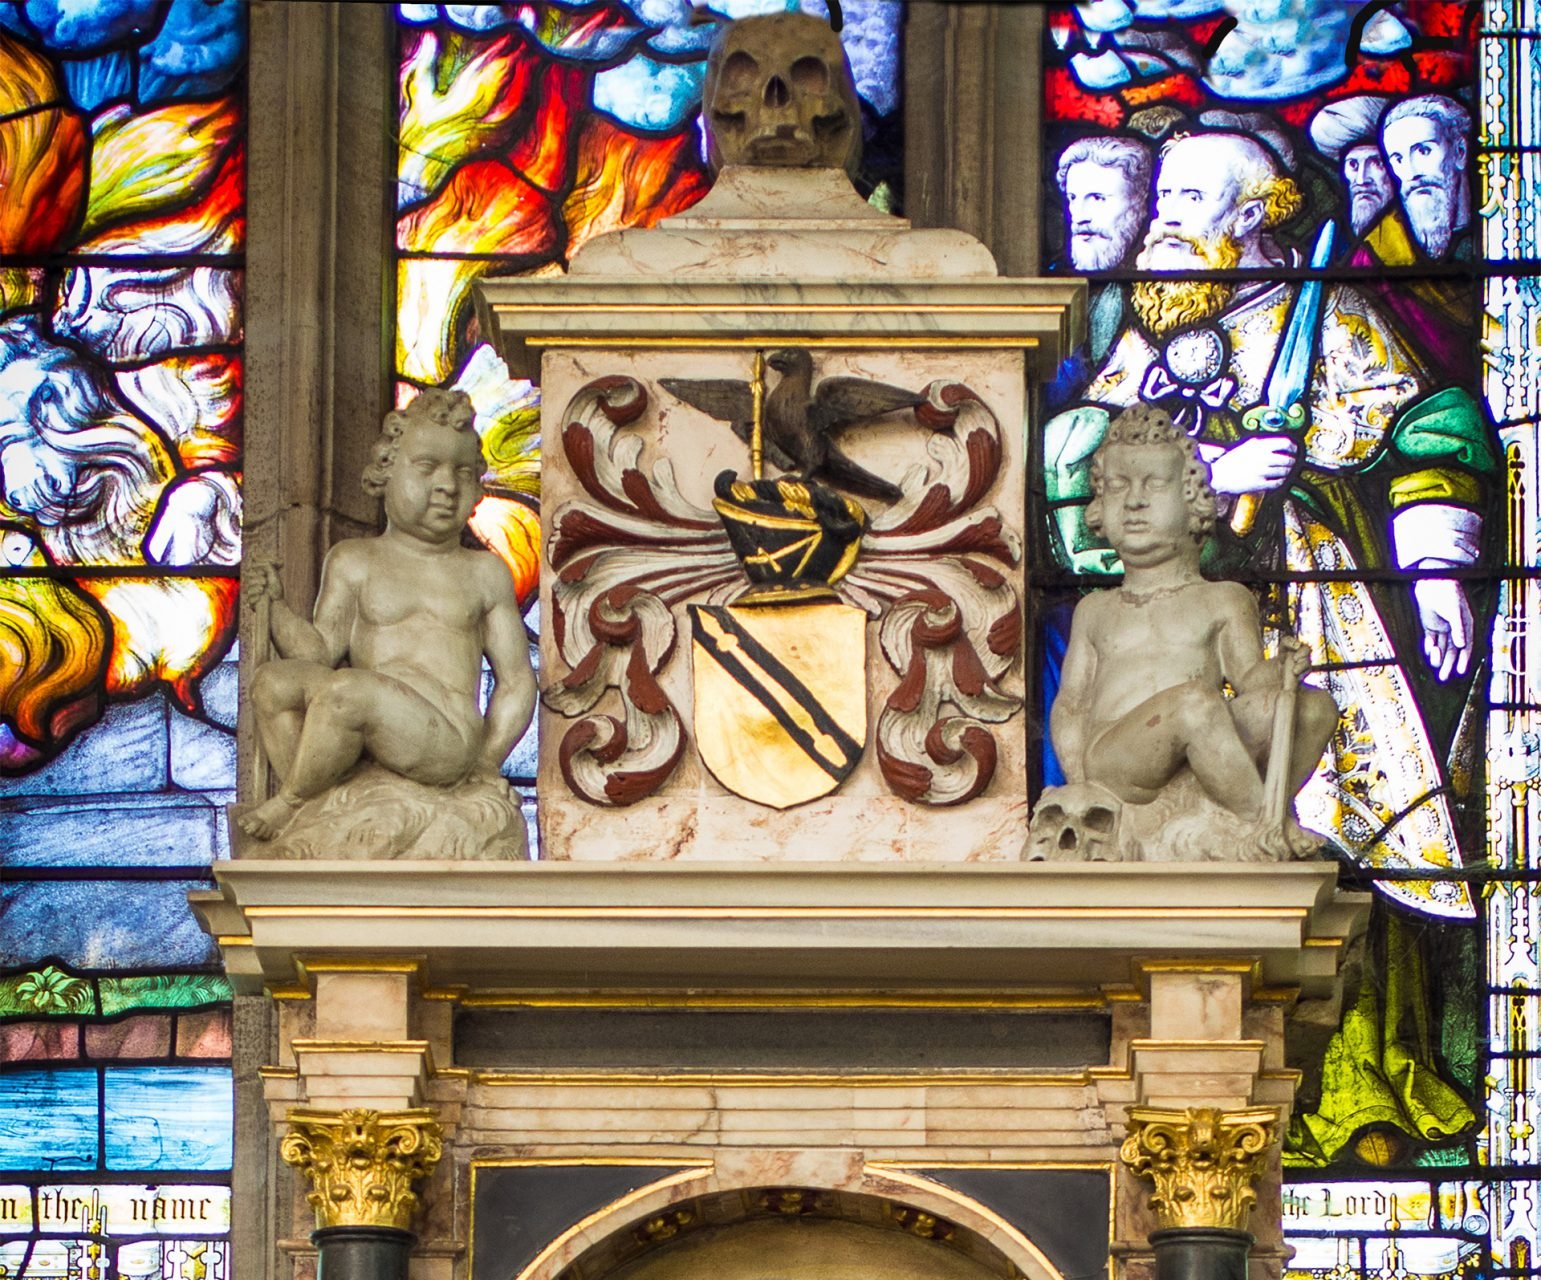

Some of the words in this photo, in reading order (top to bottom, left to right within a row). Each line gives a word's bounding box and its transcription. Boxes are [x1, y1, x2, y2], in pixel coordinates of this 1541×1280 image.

[41, 1187, 83, 1224] the
[130, 1197, 212, 1221] name
[1320, 1187, 1386, 1218] Lord
